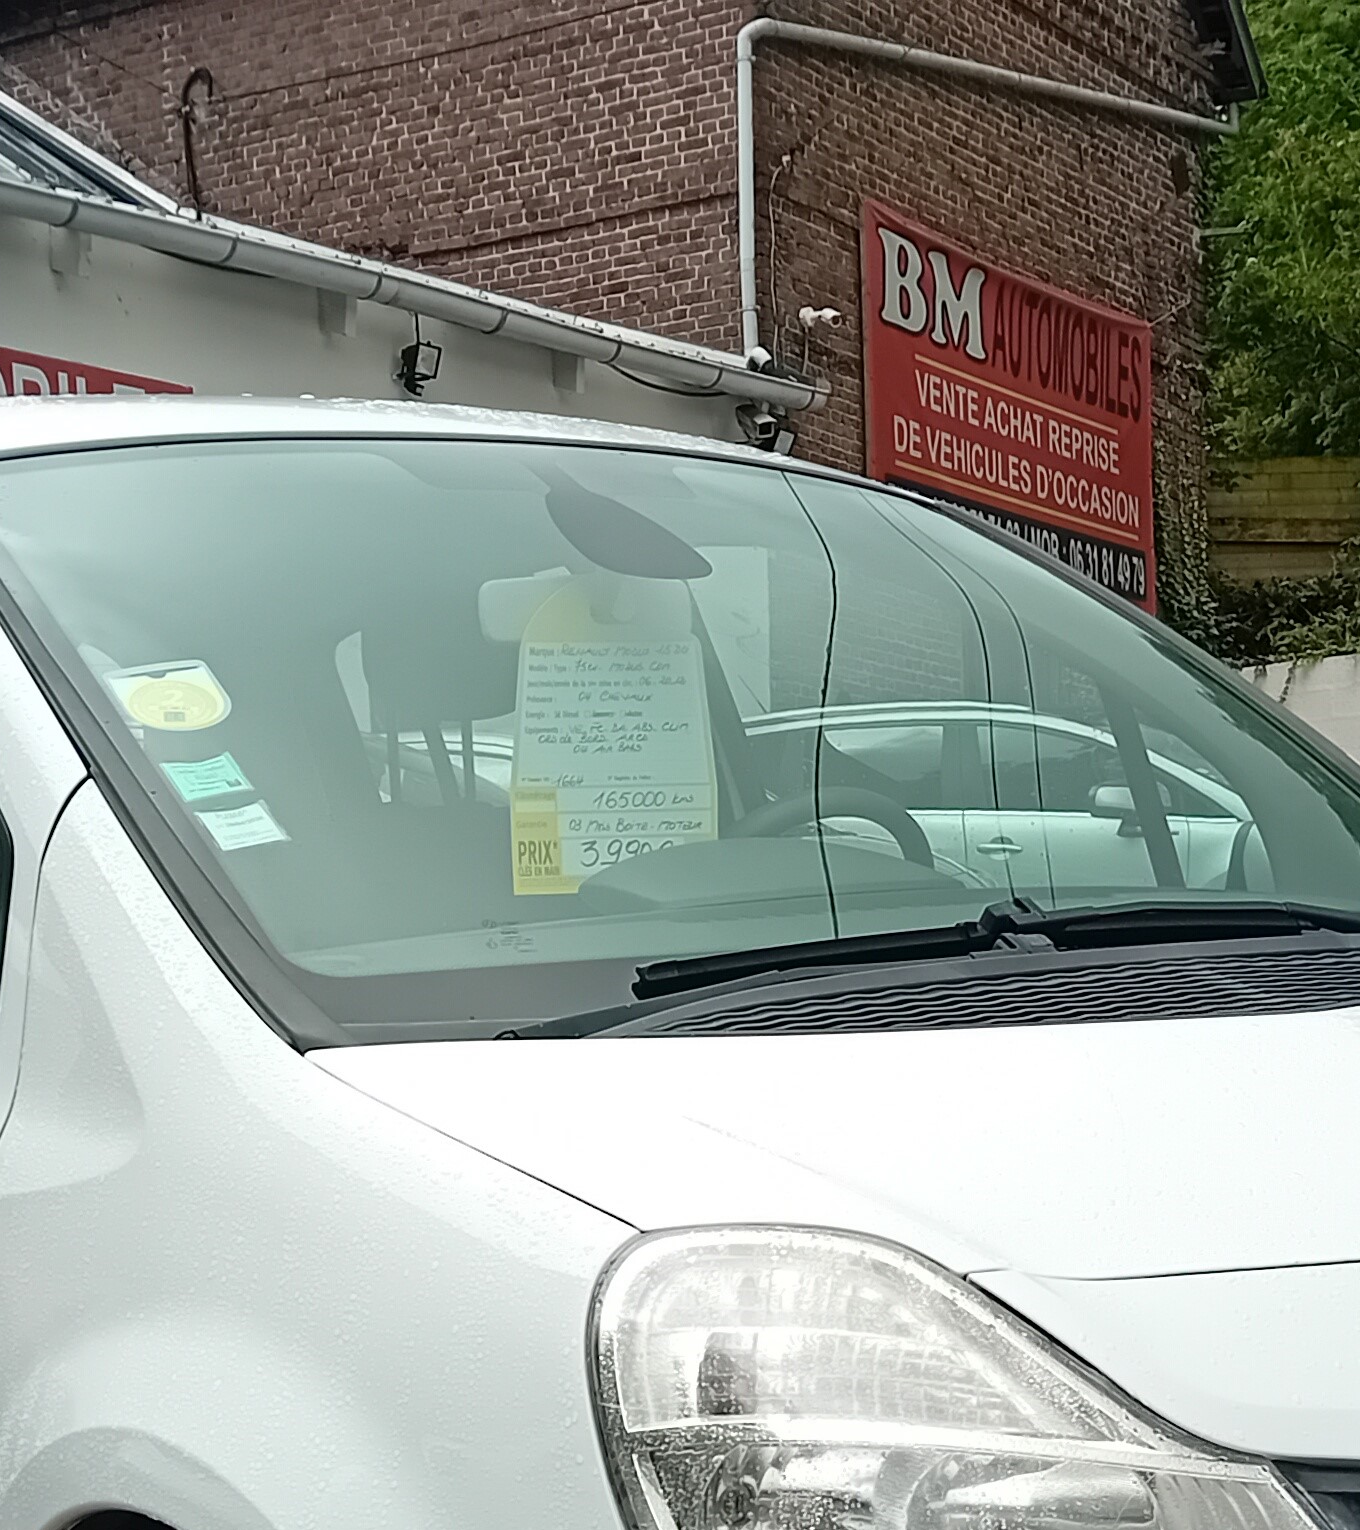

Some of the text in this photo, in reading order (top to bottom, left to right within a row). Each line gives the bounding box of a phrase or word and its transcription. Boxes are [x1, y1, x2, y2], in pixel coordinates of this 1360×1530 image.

[877, 226, 1141, 423] BM AUTOMOBILES
[893, 414, 923, 459] DE
[926, 425, 1033, 495] VEHICULES
[1036, 464, 1141, 529] D'OCCASION
[915, 369, 1121, 475] VENTE ACHAT REPRISE
[1069, 538, 1085, 576] 06
[1084, 546, 1100, 583] 31
[1101, 547, 1115, 587] 81
[1116, 552, 1131, 591] 49
[1132, 557, 1146, 596] 79
[593, 790, 667, 810] 165000
